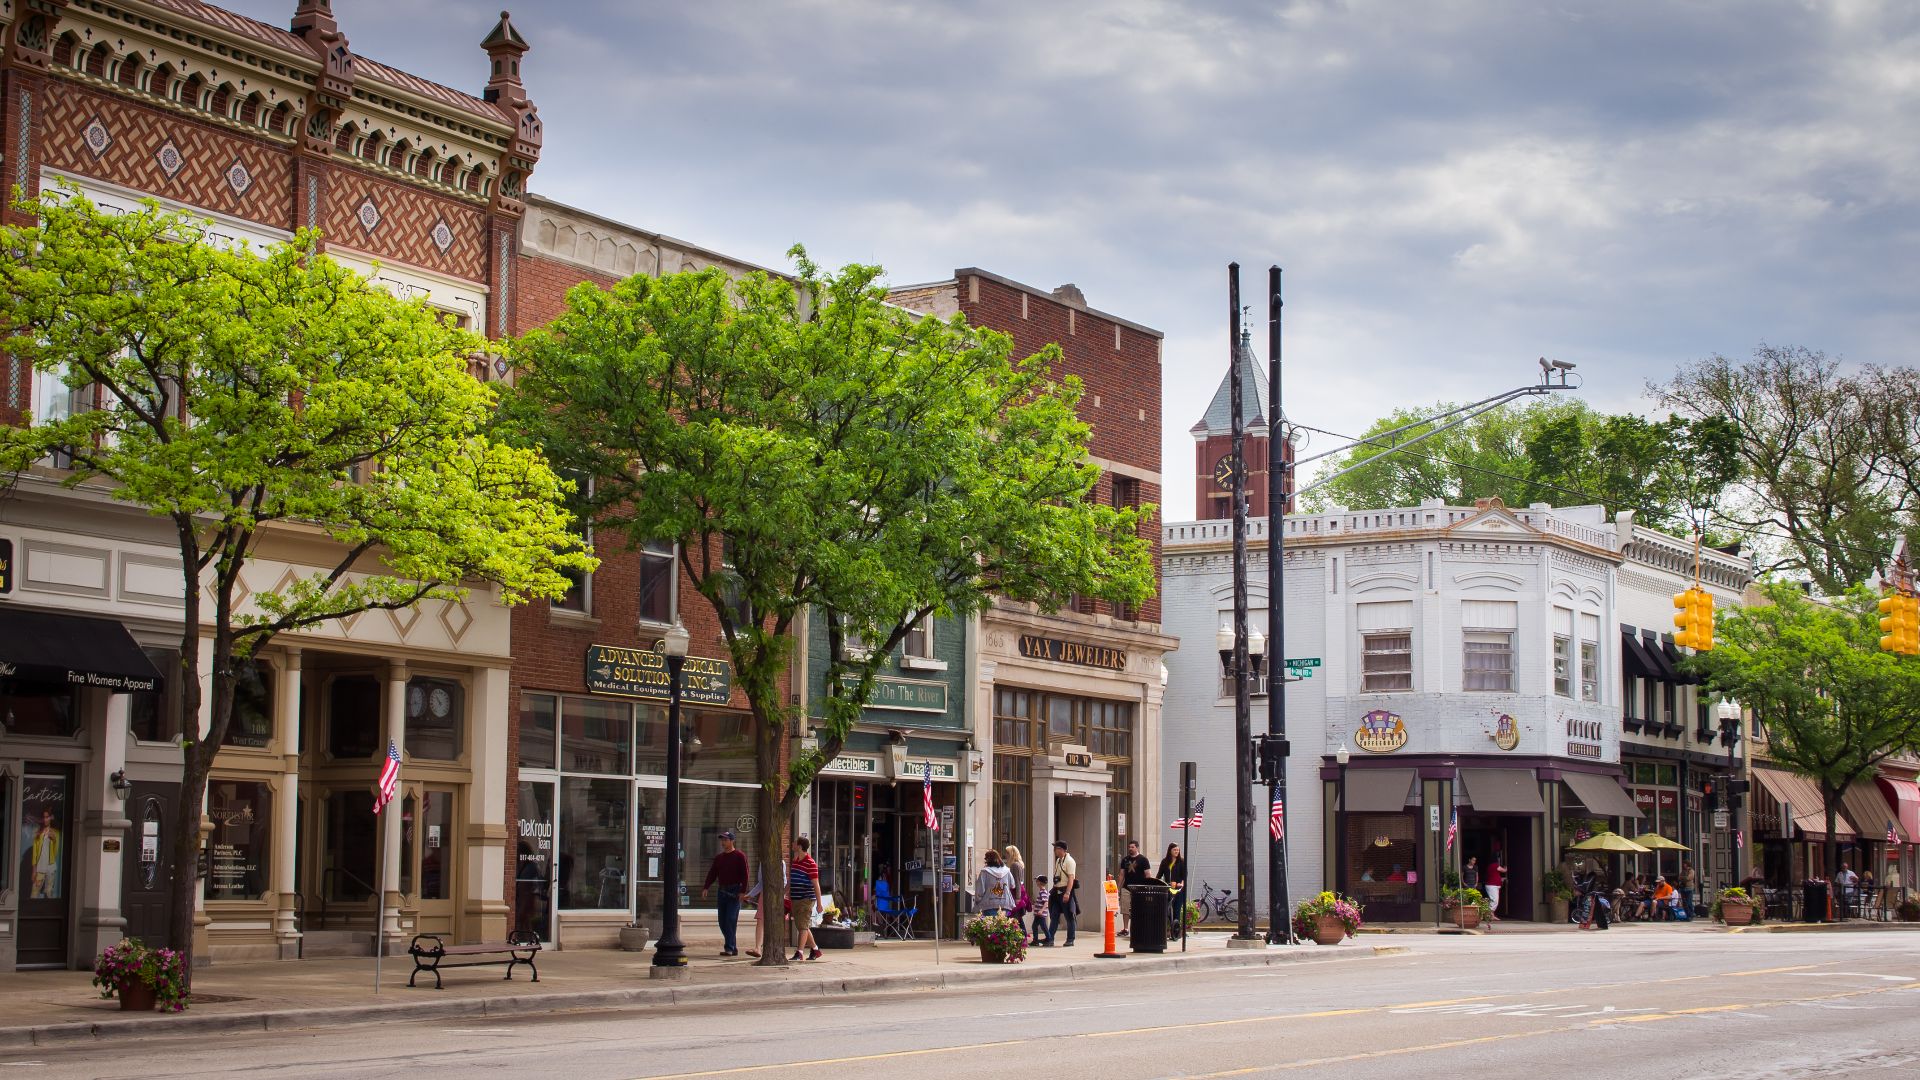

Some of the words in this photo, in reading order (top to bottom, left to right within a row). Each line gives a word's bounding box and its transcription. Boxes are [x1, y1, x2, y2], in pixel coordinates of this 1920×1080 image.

[1024, 636, 1051, 659] YAX
[1060, 642, 1126, 670] JEWELERS
[597, 648, 664, 669] ADVANCED
[681, 659, 723, 676] EDICAL
[1292, 659, 1314, 667] MICHIGAN
[67, 670, 85, 684] Fine
[87, 673, 122, 688] Womens
[123, 676, 154, 691] Apparel
[687, 675, 710, 691] INC.
[593, 680, 630, 691] Medical
[690, 691, 726, 701] Supplies
[882, 684, 895, 700] On
[898, 686, 914, 701] The
[918, 688, 940, 703] River
[824, 757, 869, 771] ollectibles
[1069, 754, 1079, 765] 102
[520, 819, 552, 837] DeKroub
[538, 837, 551, 850] Team
[905, 861, 921, 870] OPEN
